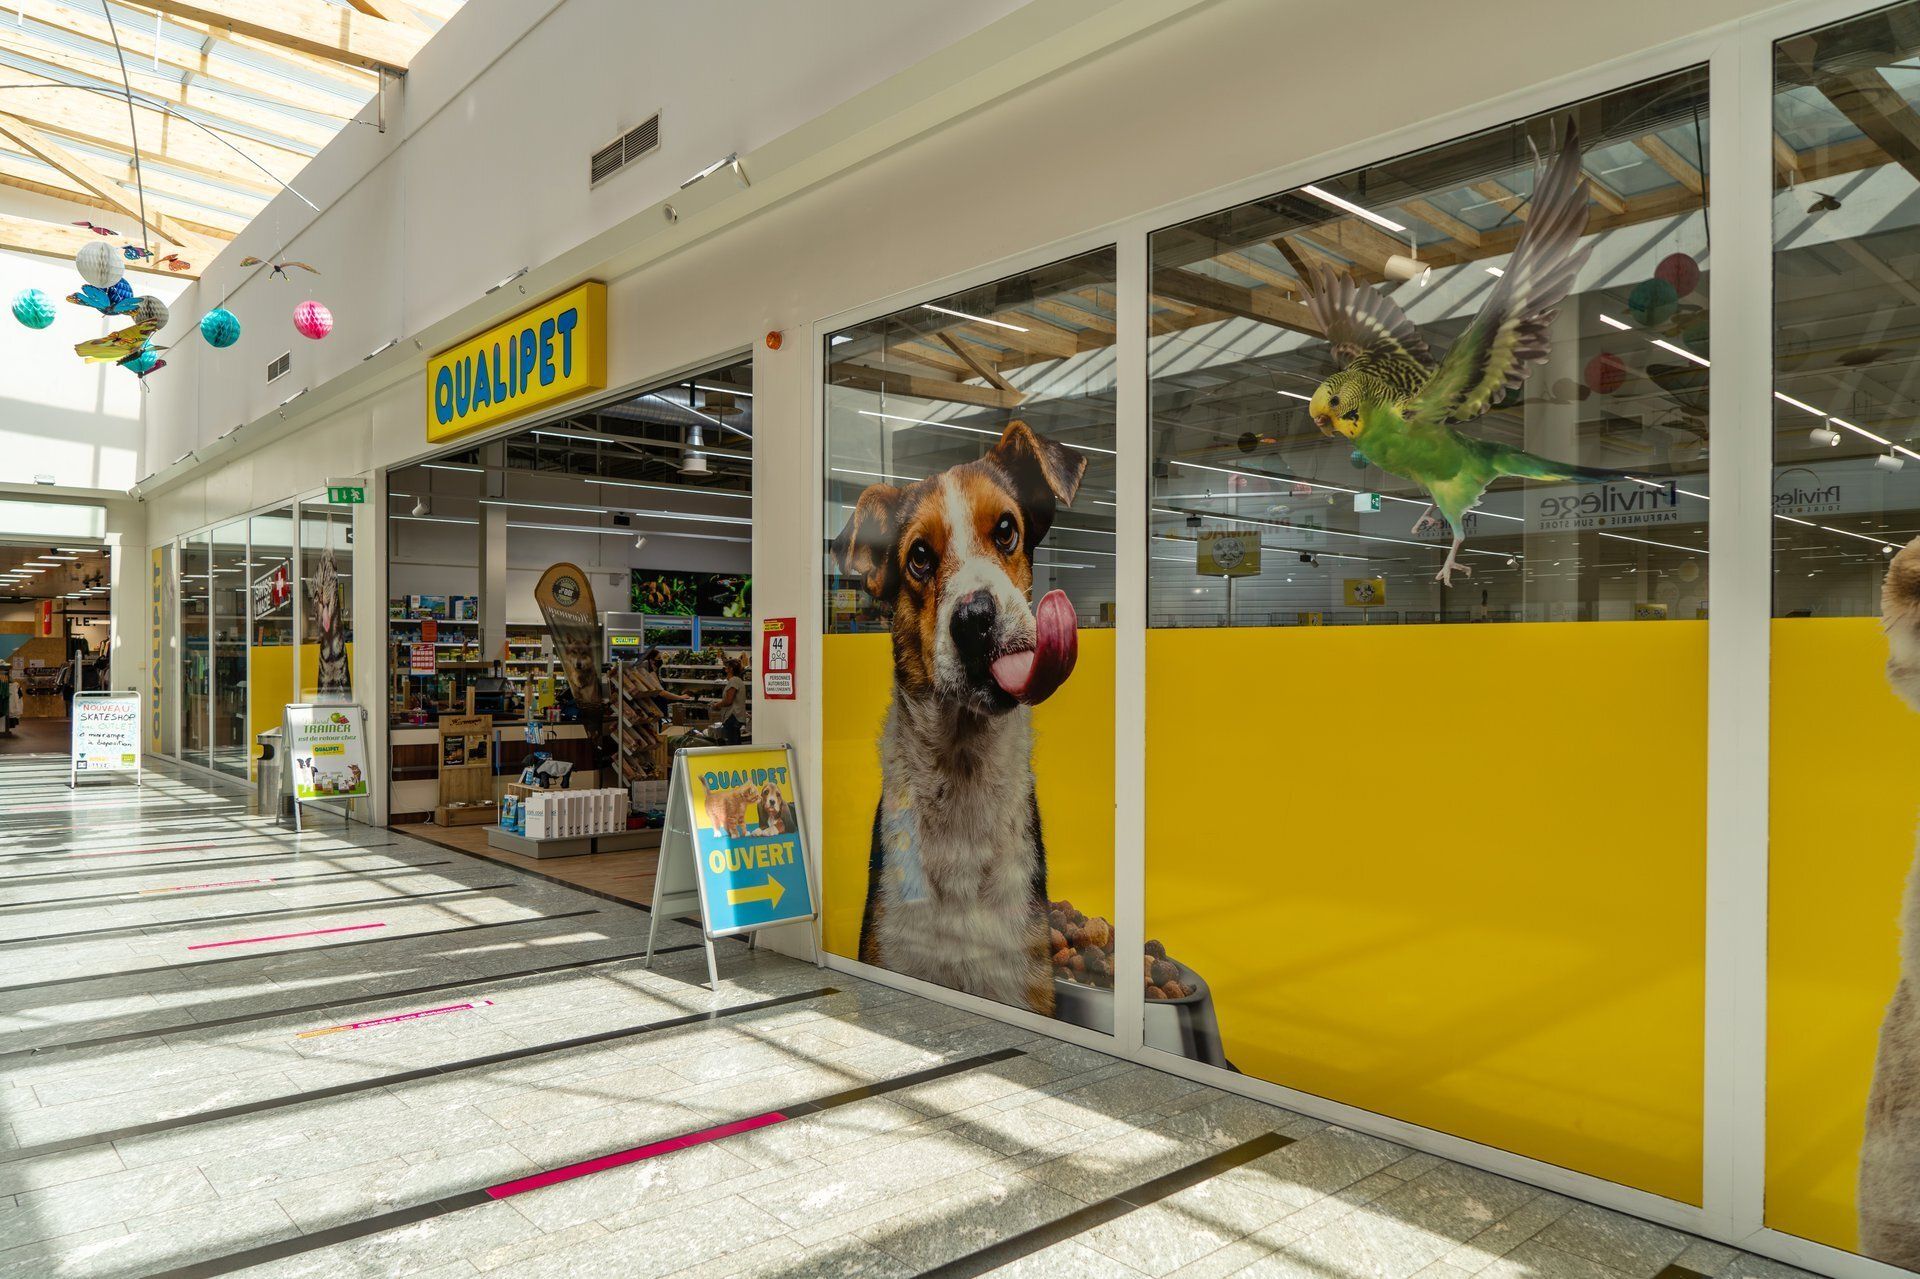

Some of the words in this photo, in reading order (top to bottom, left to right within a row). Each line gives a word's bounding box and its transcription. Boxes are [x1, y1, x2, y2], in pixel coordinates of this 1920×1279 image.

[435, 308, 577, 425] QUALIPET
[255, 576, 273, 601] SWISS
[257, 595, 271, 615] MADE
[153, 561, 161, 739] QUALIPET
[772, 638, 783, 650] 44
[80, 713, 136, 721] SKATESHOP
[83, 704, 130, 713] NOUVEAU
[303, 724, 351, 734] TRAINER
[314, 745, 340, 753] QUALIPET
[703, 766, 787, 791] QUALIPET
[709, 841, 795, 874] OUVERT
